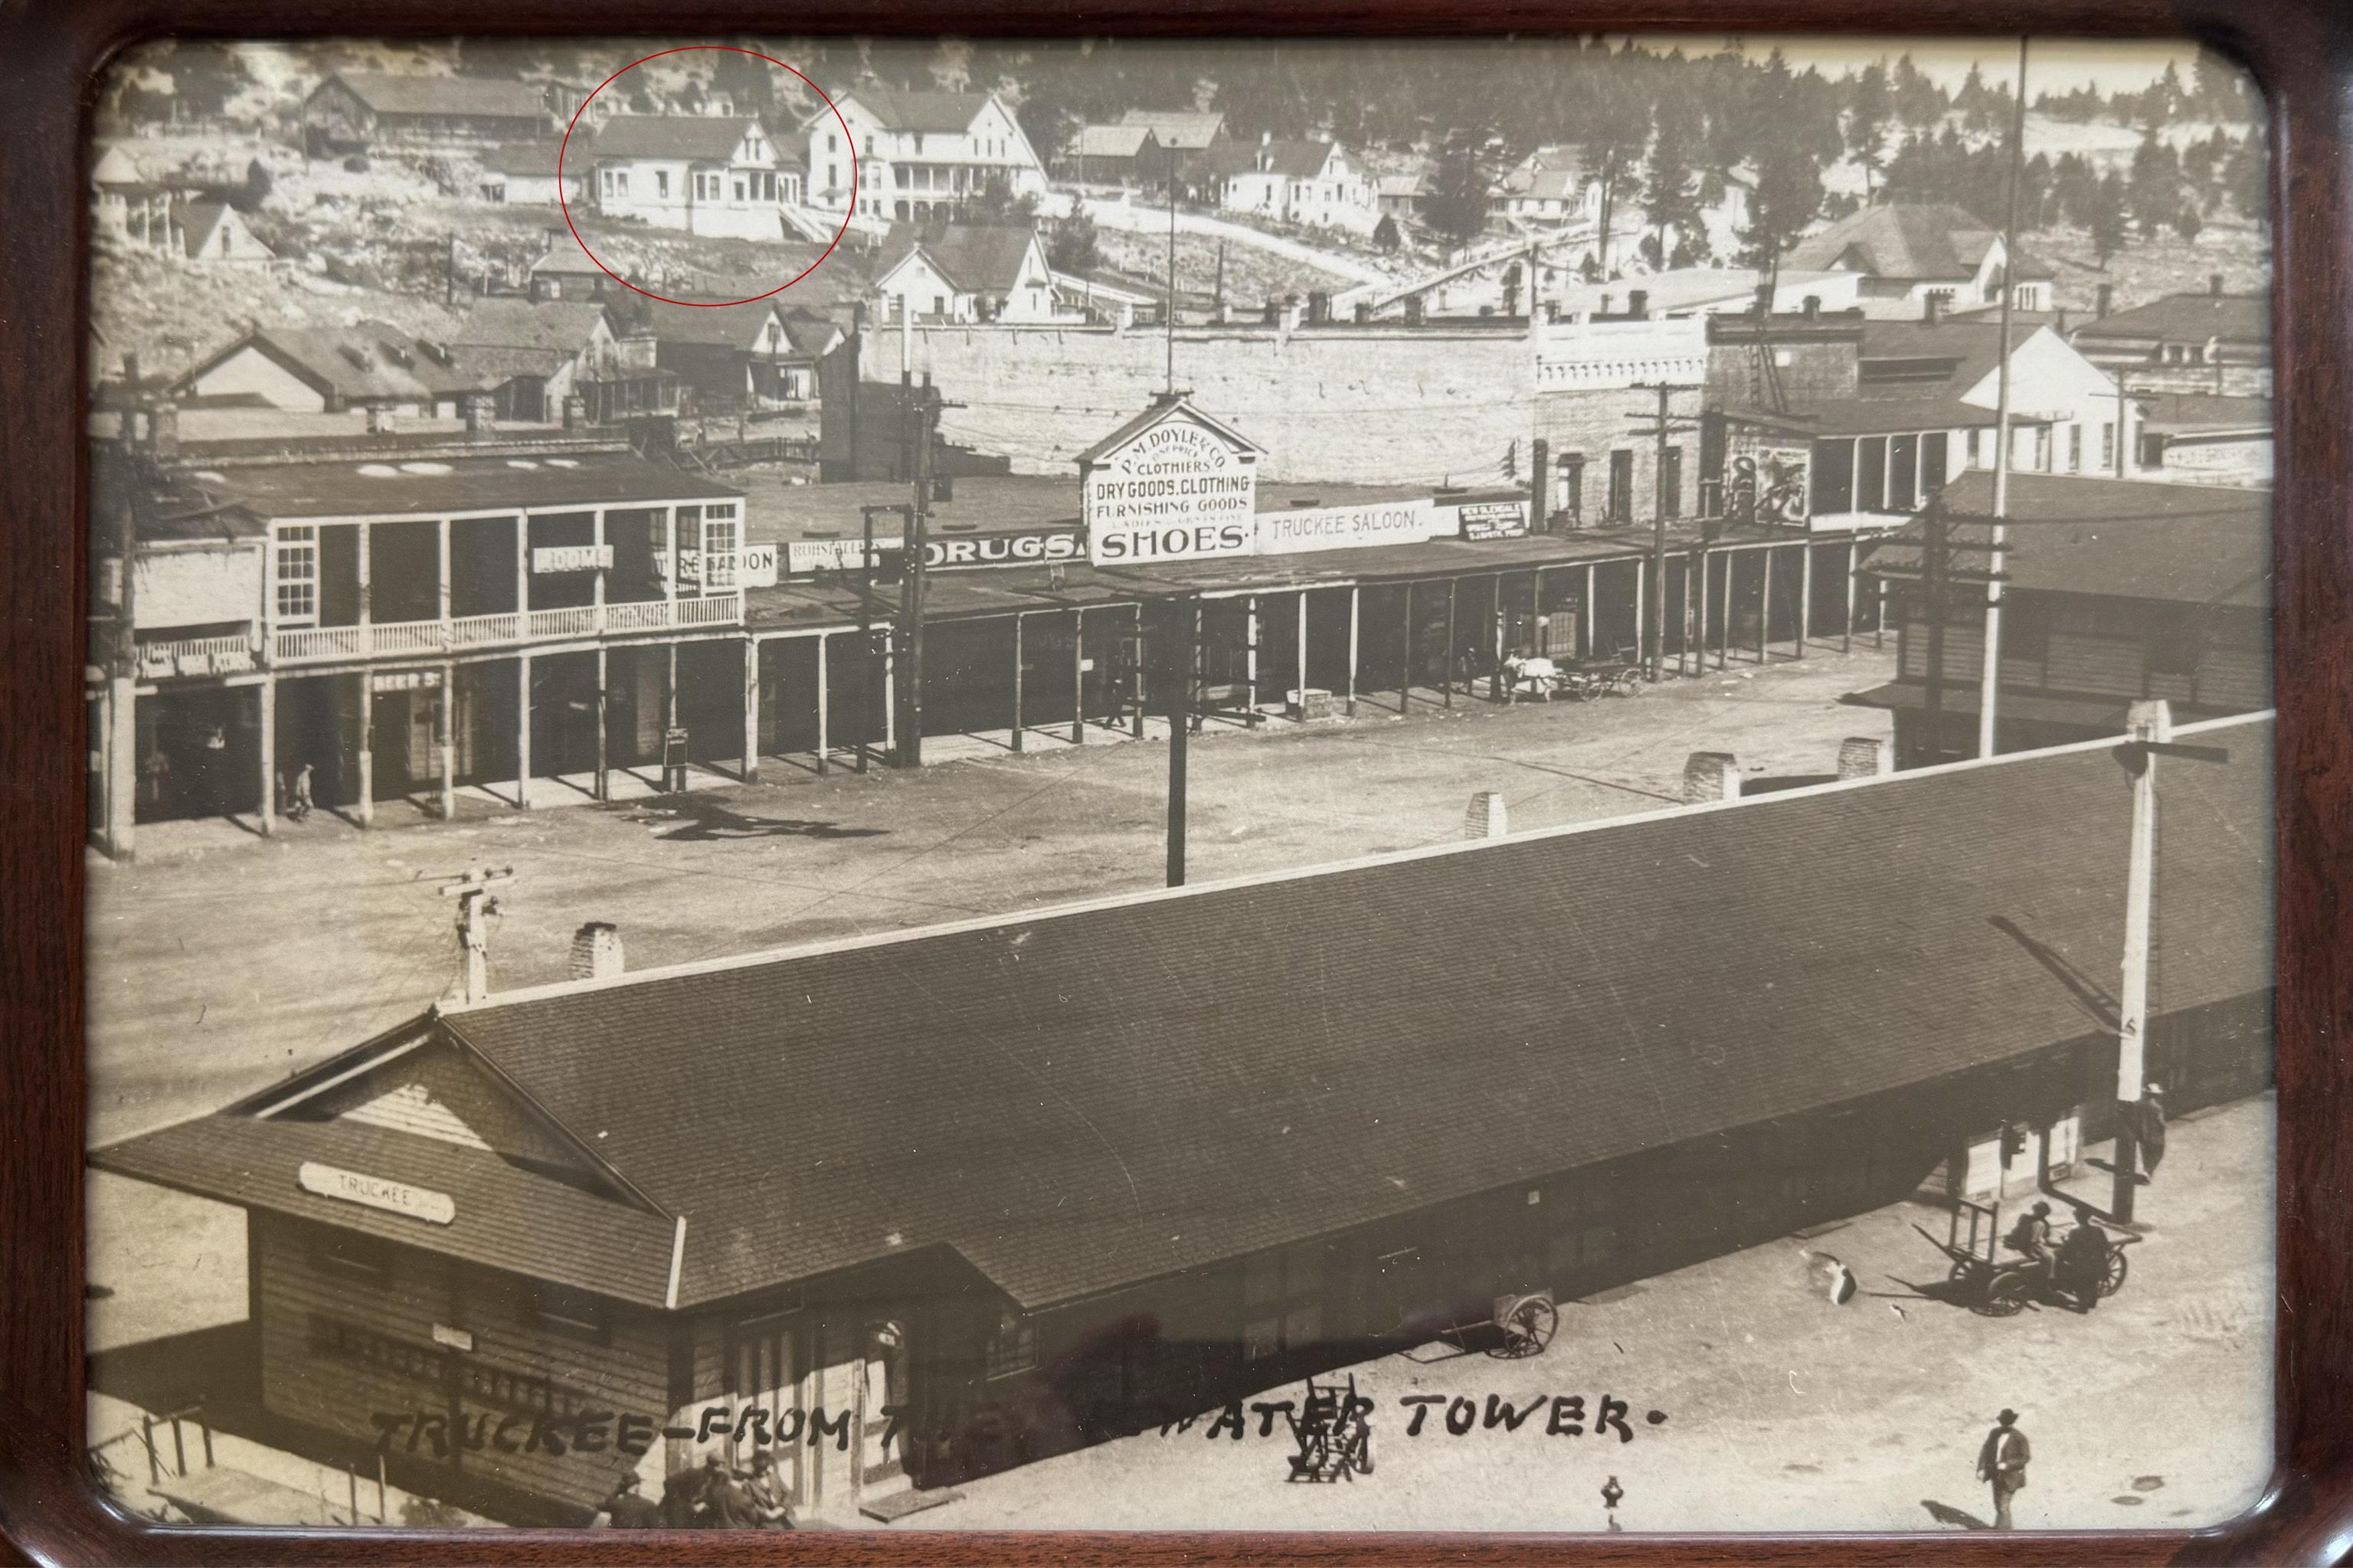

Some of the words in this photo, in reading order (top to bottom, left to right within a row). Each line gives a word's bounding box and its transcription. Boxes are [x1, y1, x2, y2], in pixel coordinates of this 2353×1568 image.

[1150, 429, 1199, 448] DOYLE
[1137, 461, 1211, 476] CLOTHIERS
[1097, 482, 1125, 500] DRY
[1180, 476, 1250, 496] CLOTHING
[1197, 497, 1248, 512] GOODS
[1271, 514, 1346, 539] TRUCKEE
[925, 534, 1076, 567] DRUGS
[339, 1174, 413, 1206] TRUCKEE
